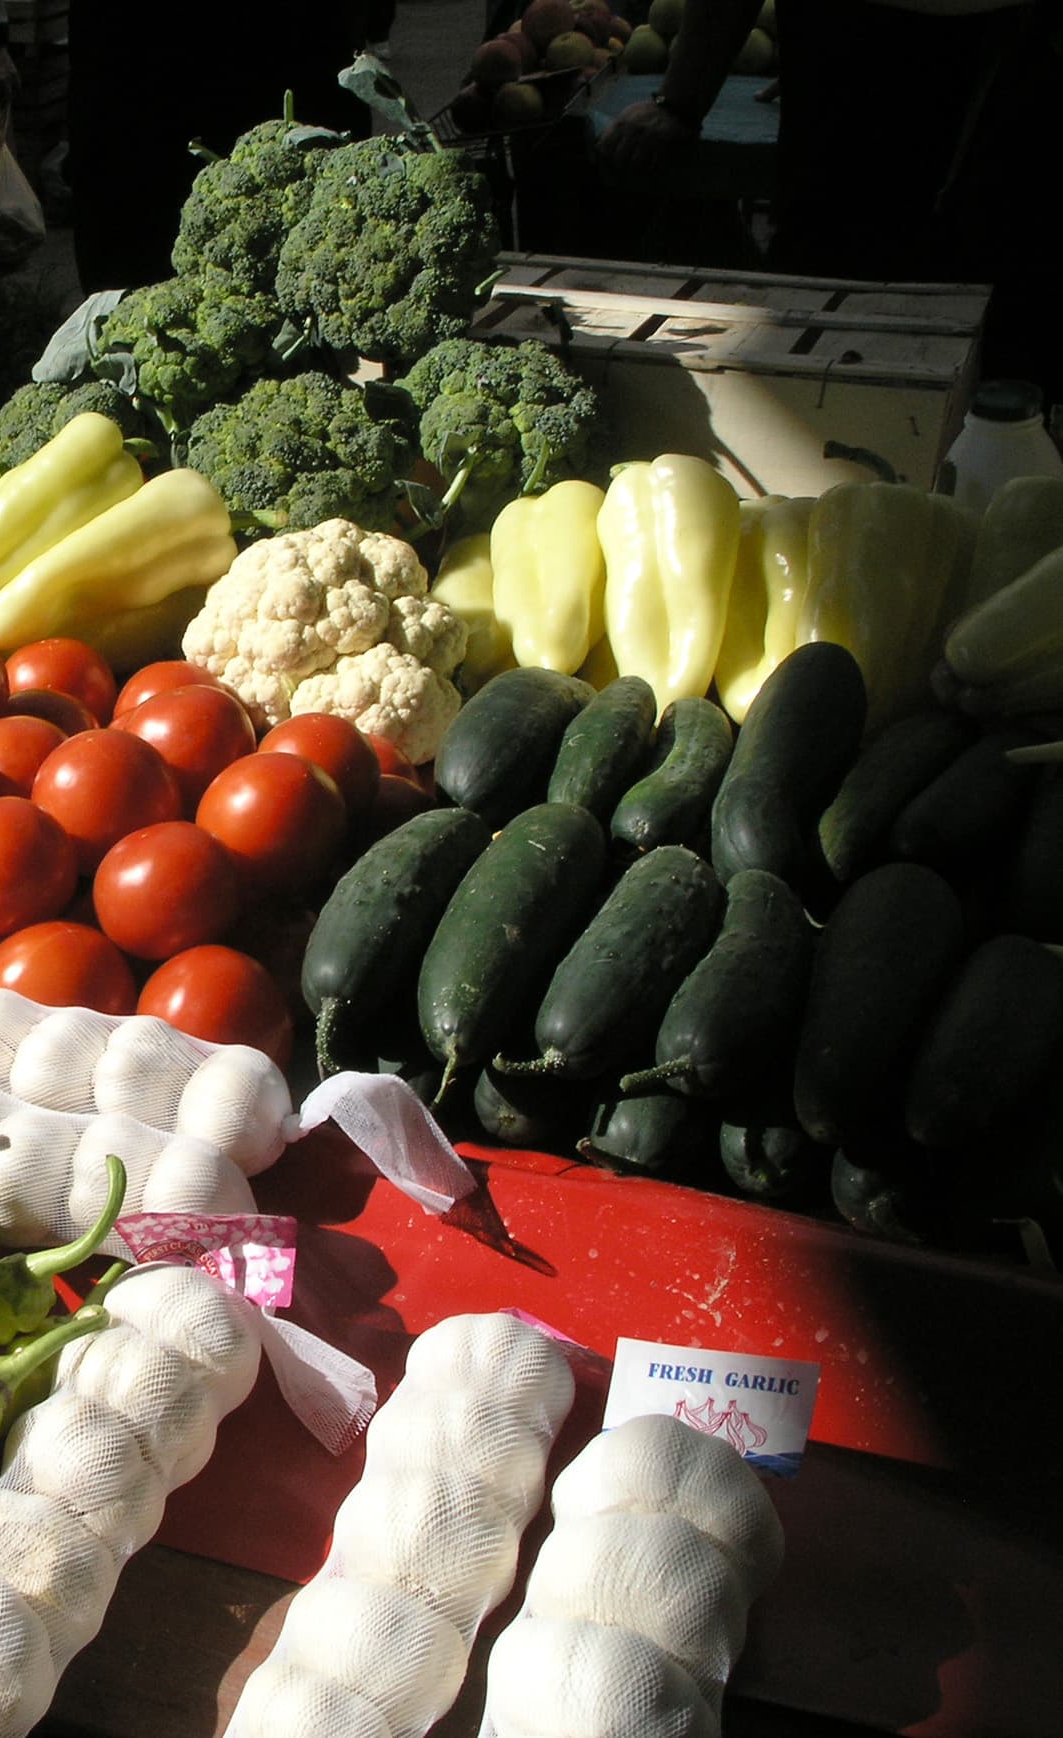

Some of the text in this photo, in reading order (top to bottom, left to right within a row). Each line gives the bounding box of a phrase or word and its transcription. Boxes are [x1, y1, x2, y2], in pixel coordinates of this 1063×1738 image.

[142, 1244, 170, 1262] FIRST
[648, 1362, 800, 1395] FRESH GARLIC
